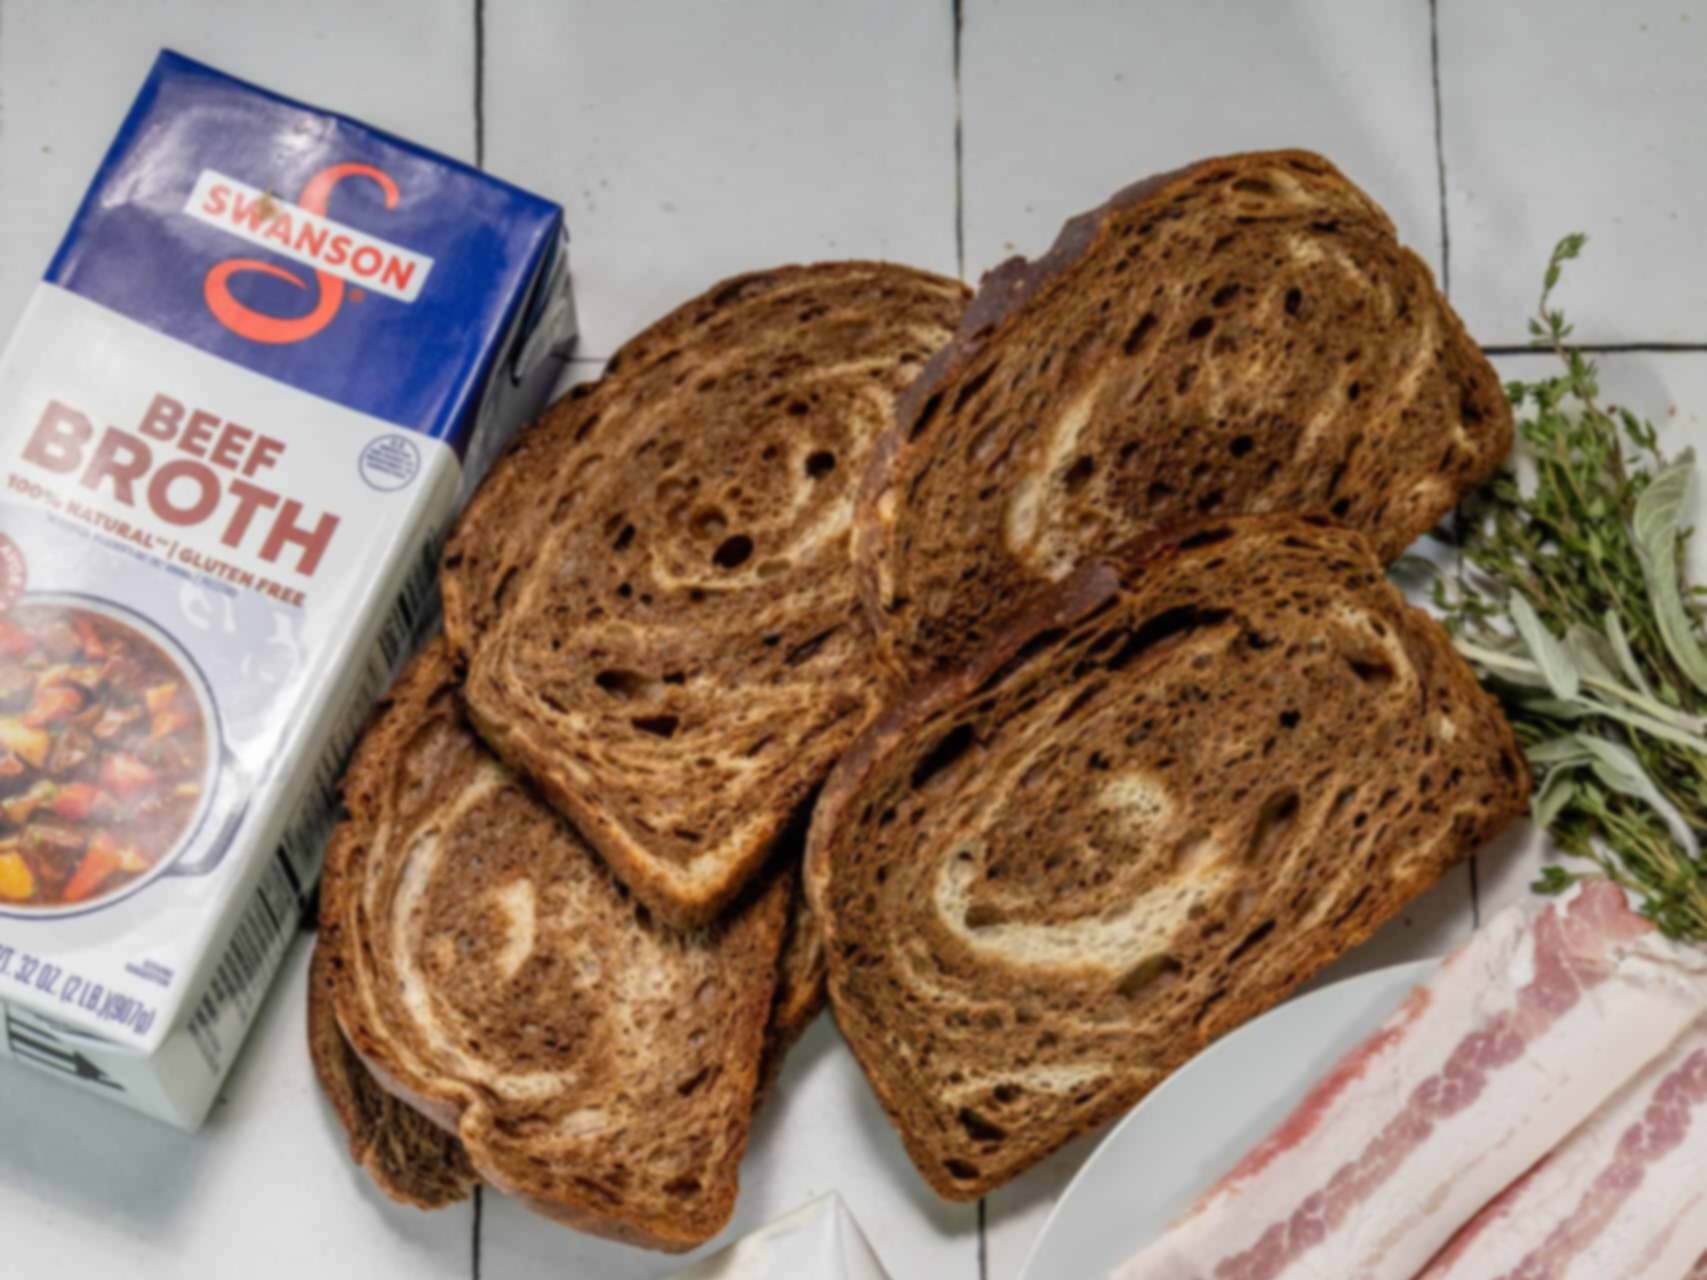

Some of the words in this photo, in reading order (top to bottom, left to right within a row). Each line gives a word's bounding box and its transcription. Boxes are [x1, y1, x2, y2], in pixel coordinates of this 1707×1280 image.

[203, 184, 416, 291] SWANSON
[137, 392, 286, 477] BEEF
[6, 474, 62, 508] 100%
[178, 548, 255, 590] GLUTEN
[255, 576, 307, 607] FREE
[21, 399, 341, 578] BROTH
[14, 954, 39, 985] 32
[60, 974, 82, 1003] (2
